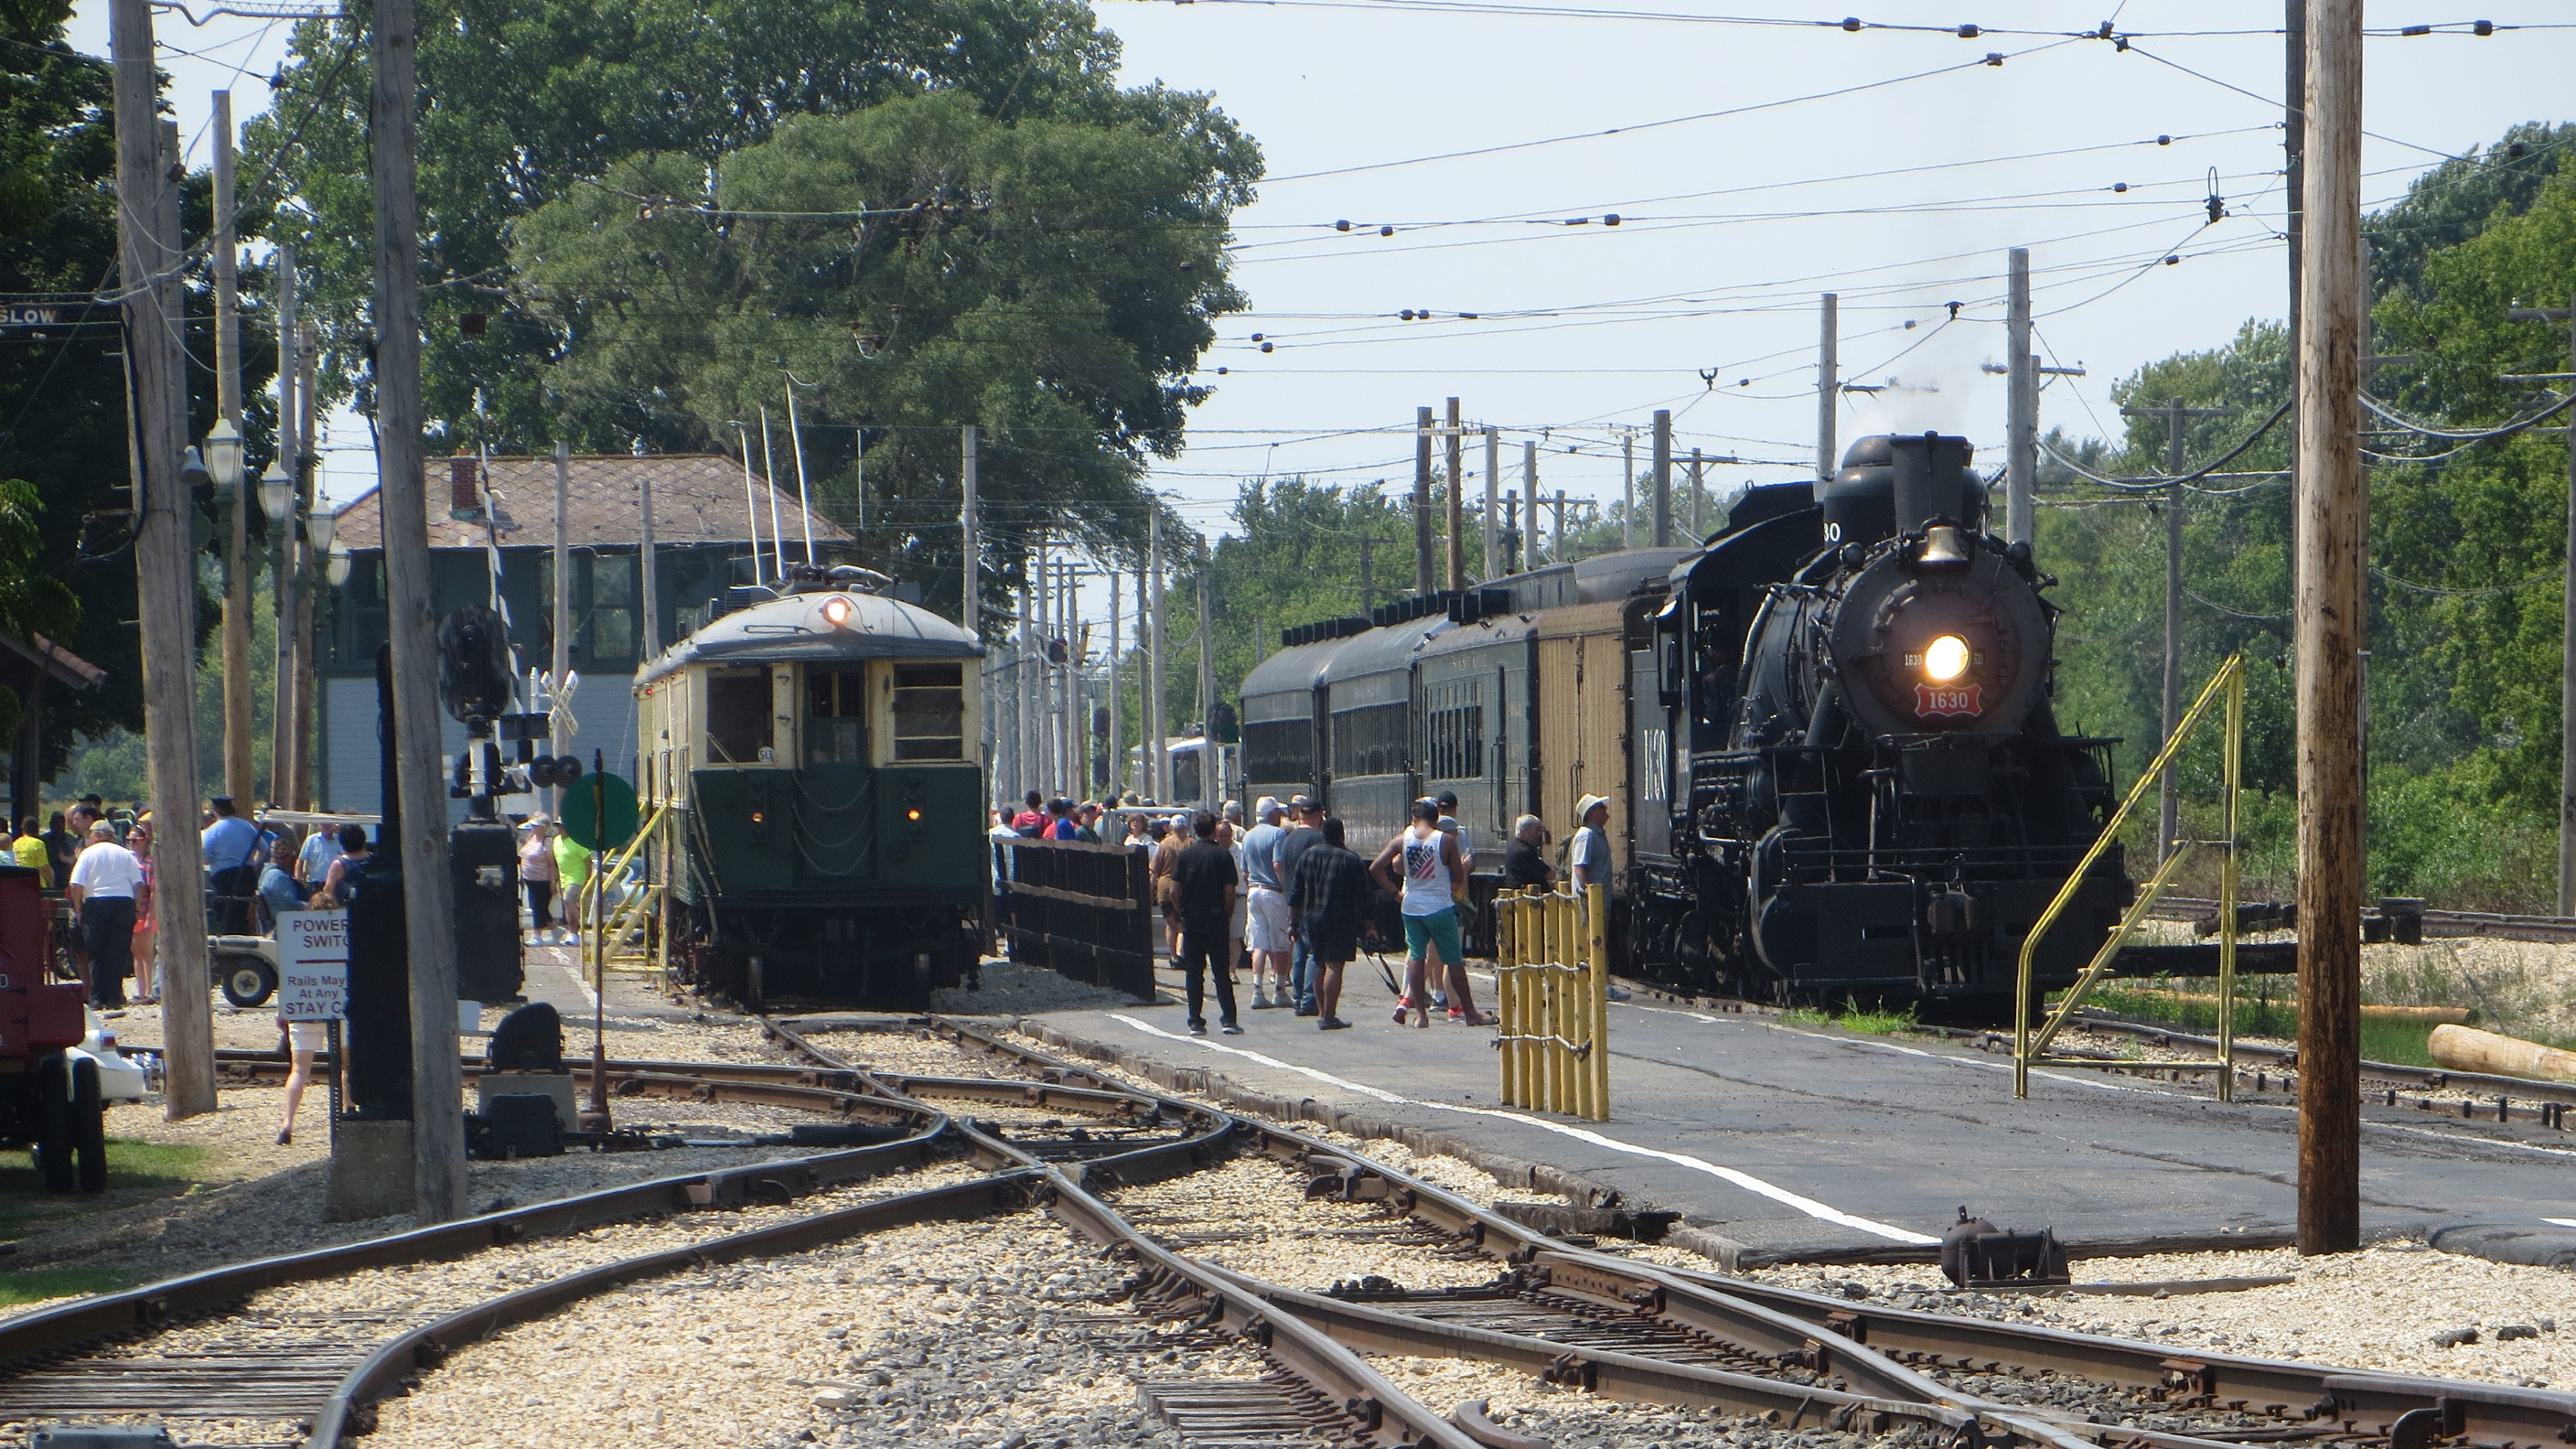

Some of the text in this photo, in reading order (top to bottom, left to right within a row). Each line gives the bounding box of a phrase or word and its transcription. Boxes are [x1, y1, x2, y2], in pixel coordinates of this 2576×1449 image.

[1905, 653, 1923, 666] 1630
[1929, 692, 1968, 709] 1630
[287, 976, 346, 988] Rails May
[299, 989, 313, 999] At
[316, 989, 338, 1000] Any
[285, 1002, 327, 1014] STAY
